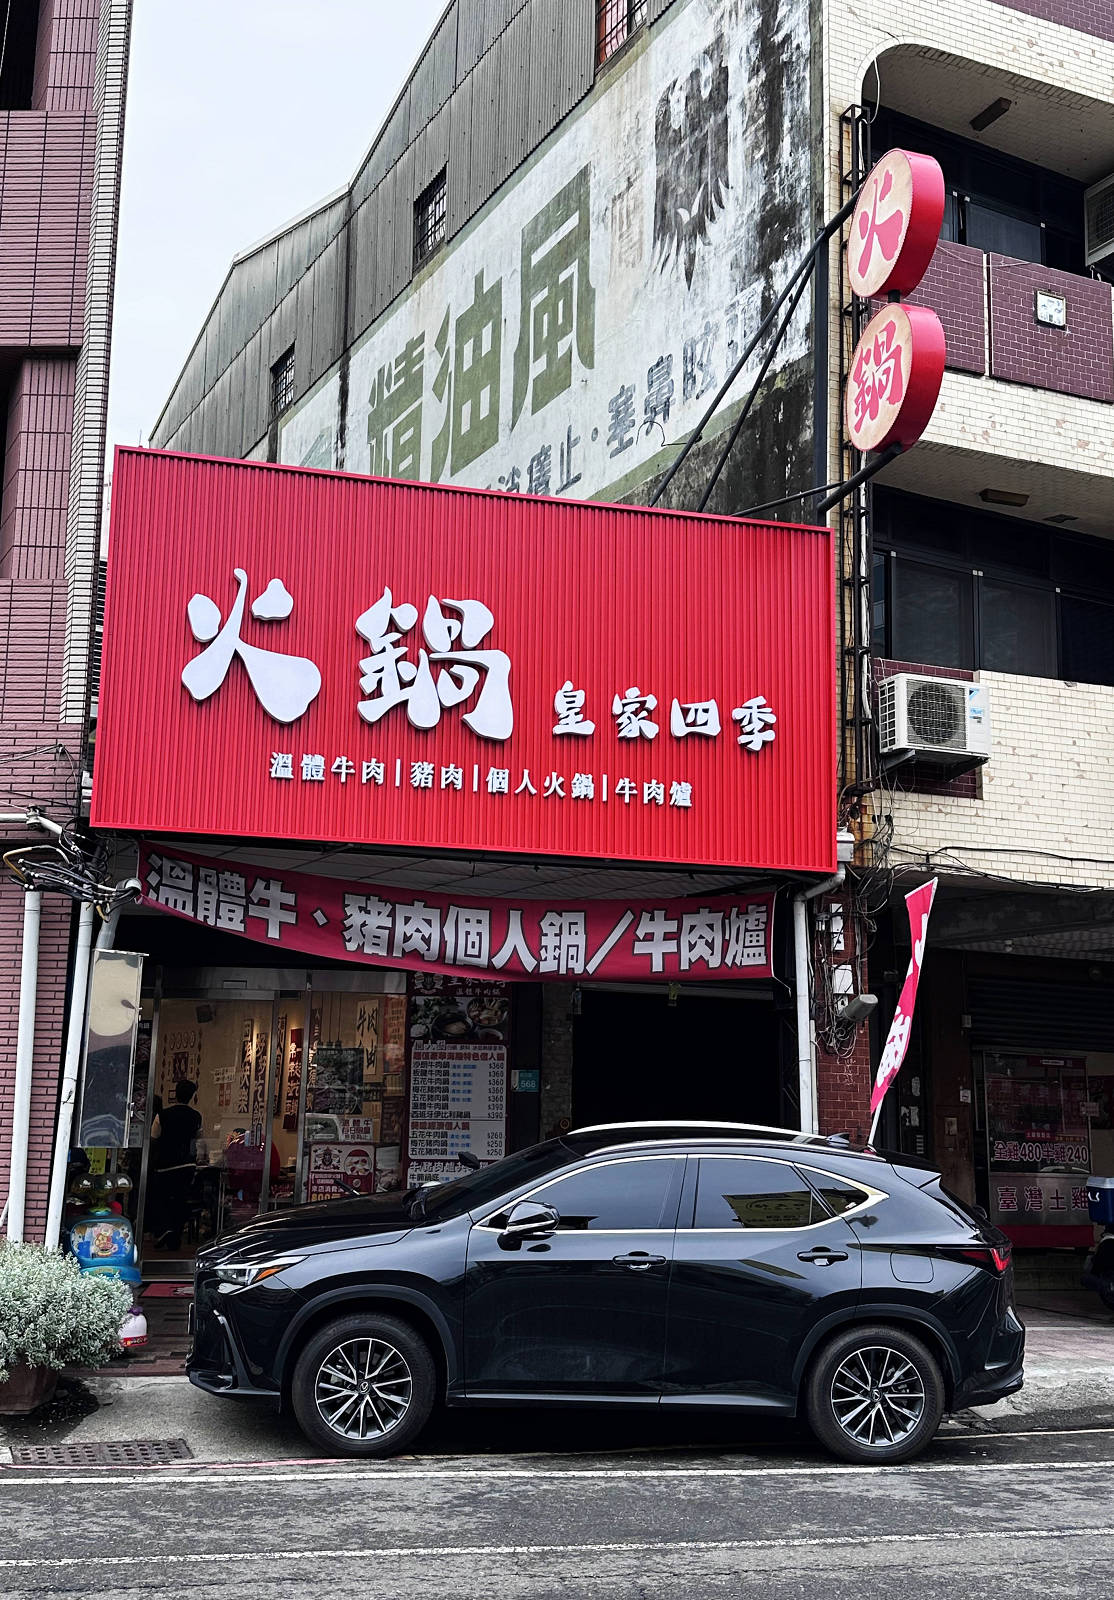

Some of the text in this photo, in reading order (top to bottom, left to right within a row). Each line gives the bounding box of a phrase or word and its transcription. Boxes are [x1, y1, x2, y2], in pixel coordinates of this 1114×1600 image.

[181, 567, 777, 751] 火鍋 皇家四季
[520, 1080, 536, 1088] 568
[997, 1185, 1089, 1213] 臺灣土雞
